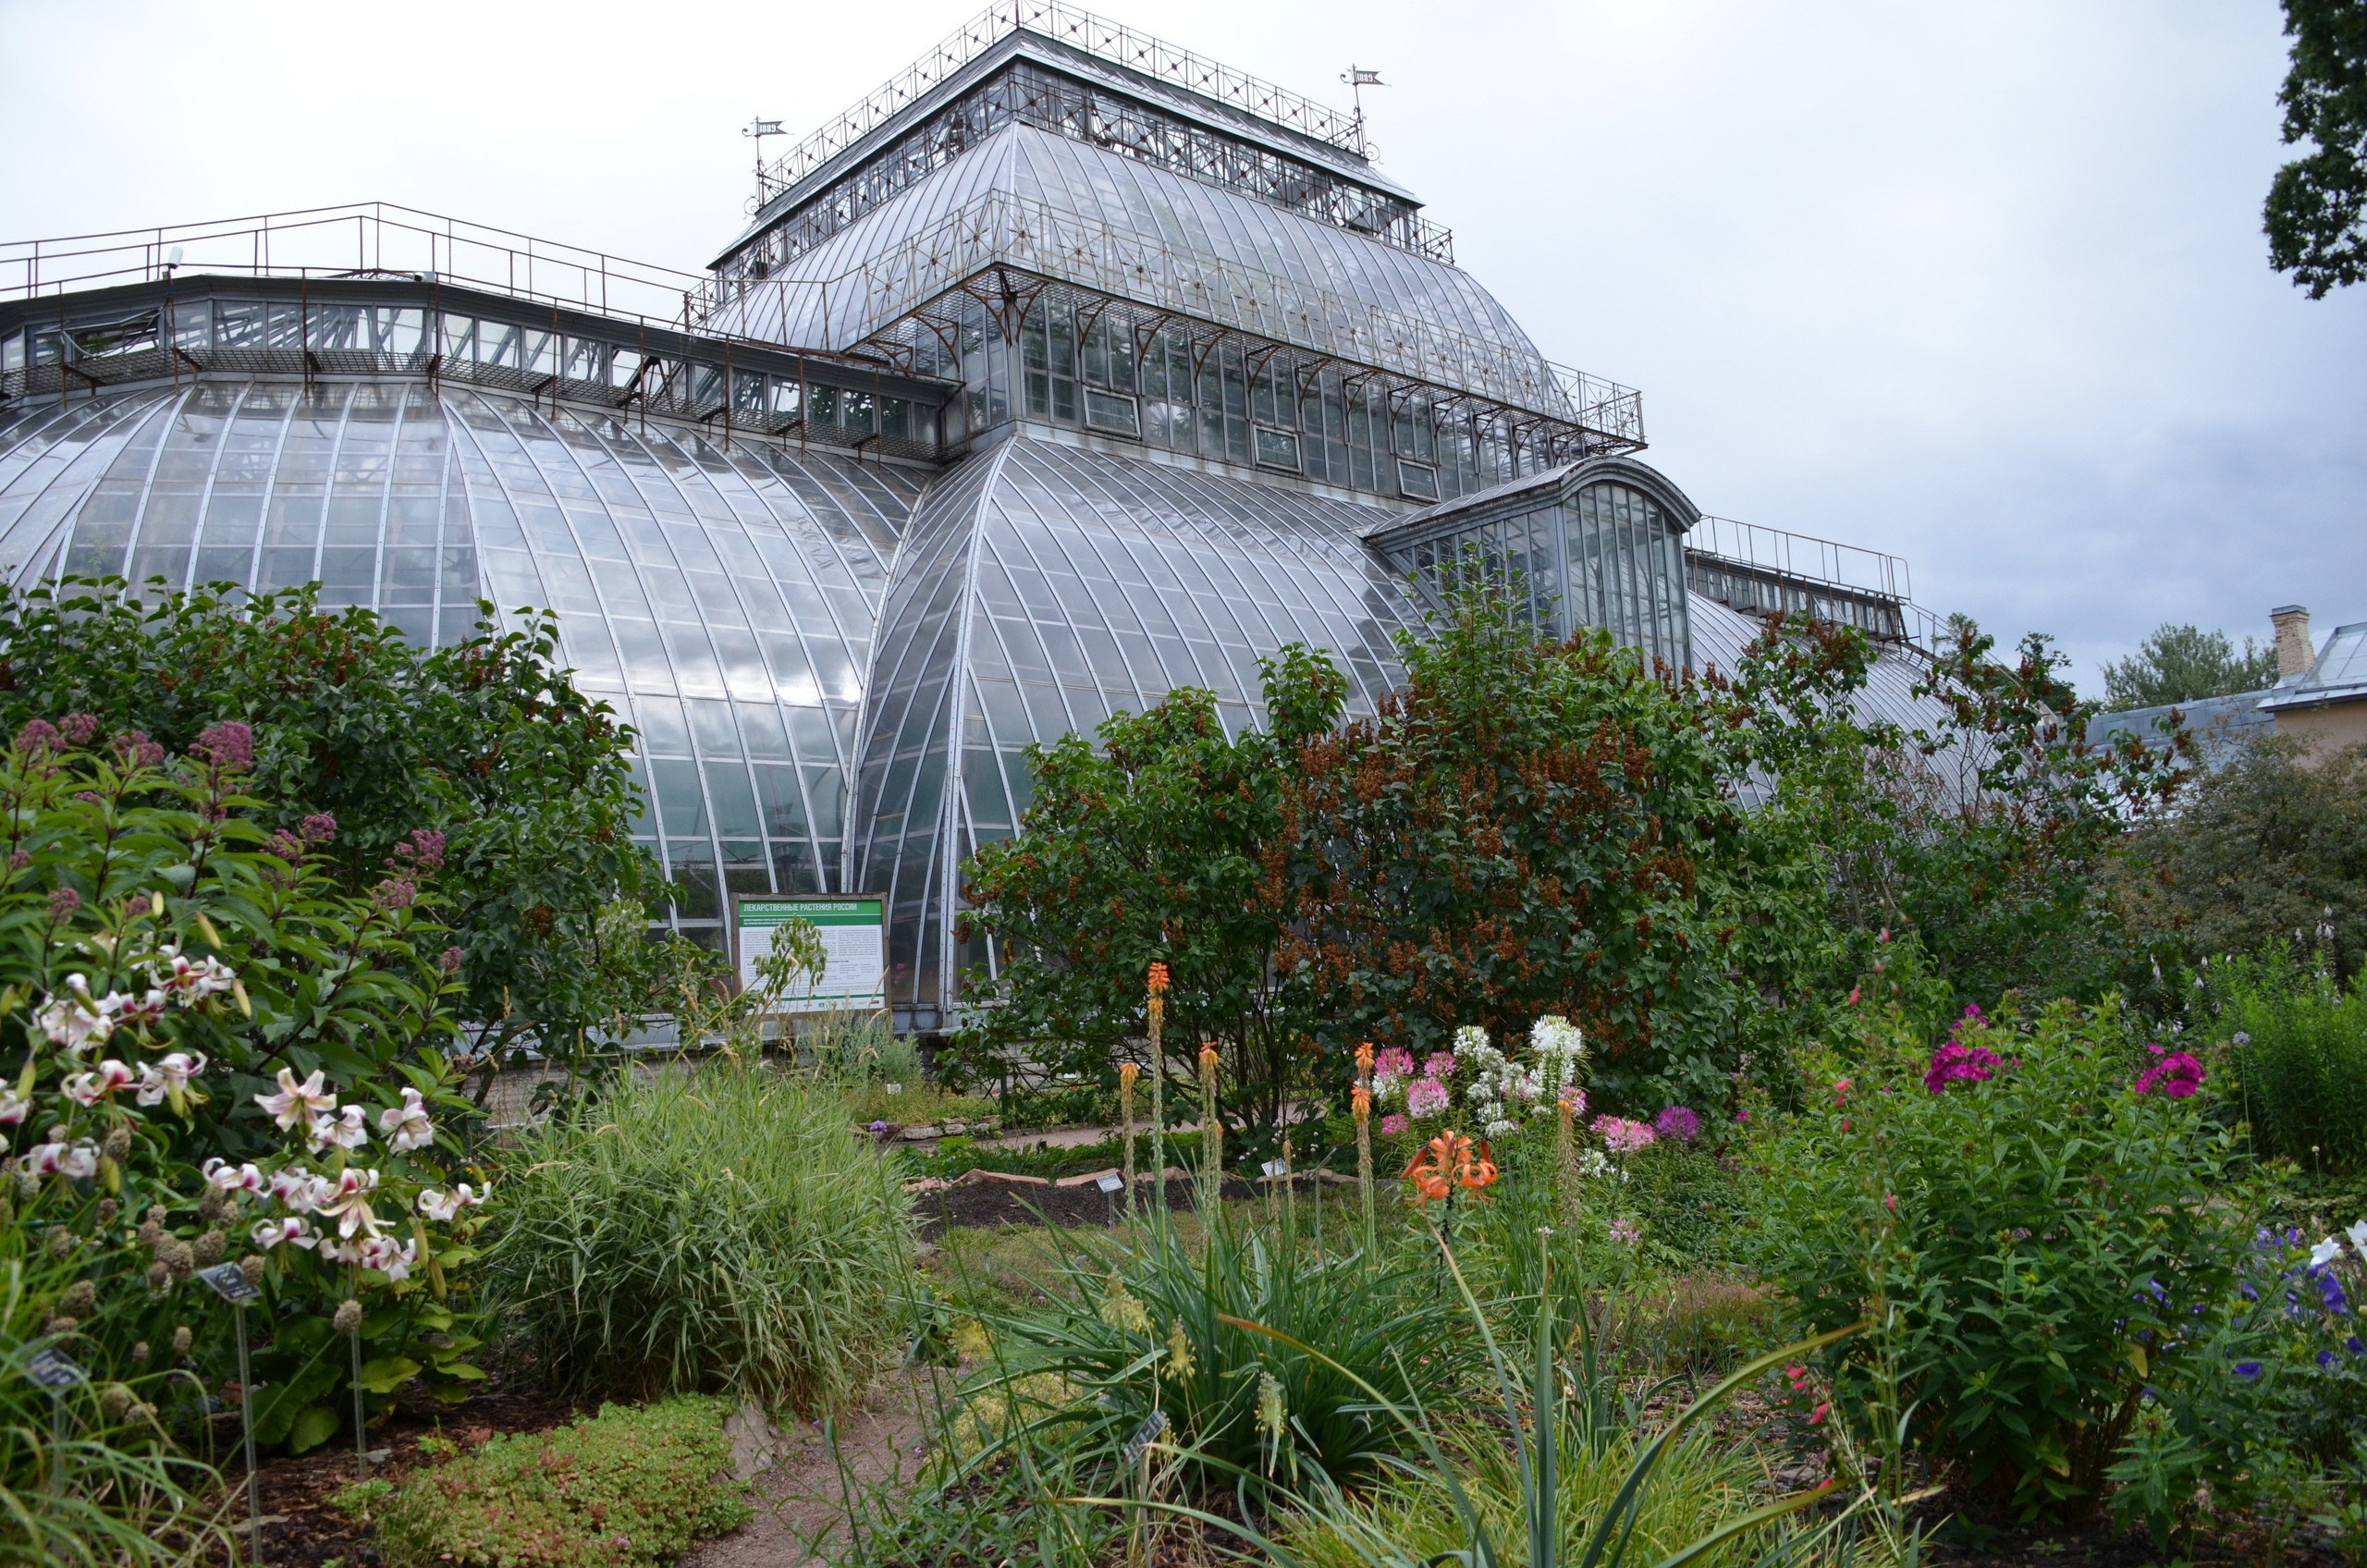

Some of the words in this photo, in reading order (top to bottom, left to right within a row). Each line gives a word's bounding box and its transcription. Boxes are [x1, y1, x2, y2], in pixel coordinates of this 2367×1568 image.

[743, 903, 799, 912] ЛЕКАРСТВЕННЫЕ
[800, 903, 832, 912] РАСТЕНИЯ
[833, 902, 858, 911] РОССИИ
